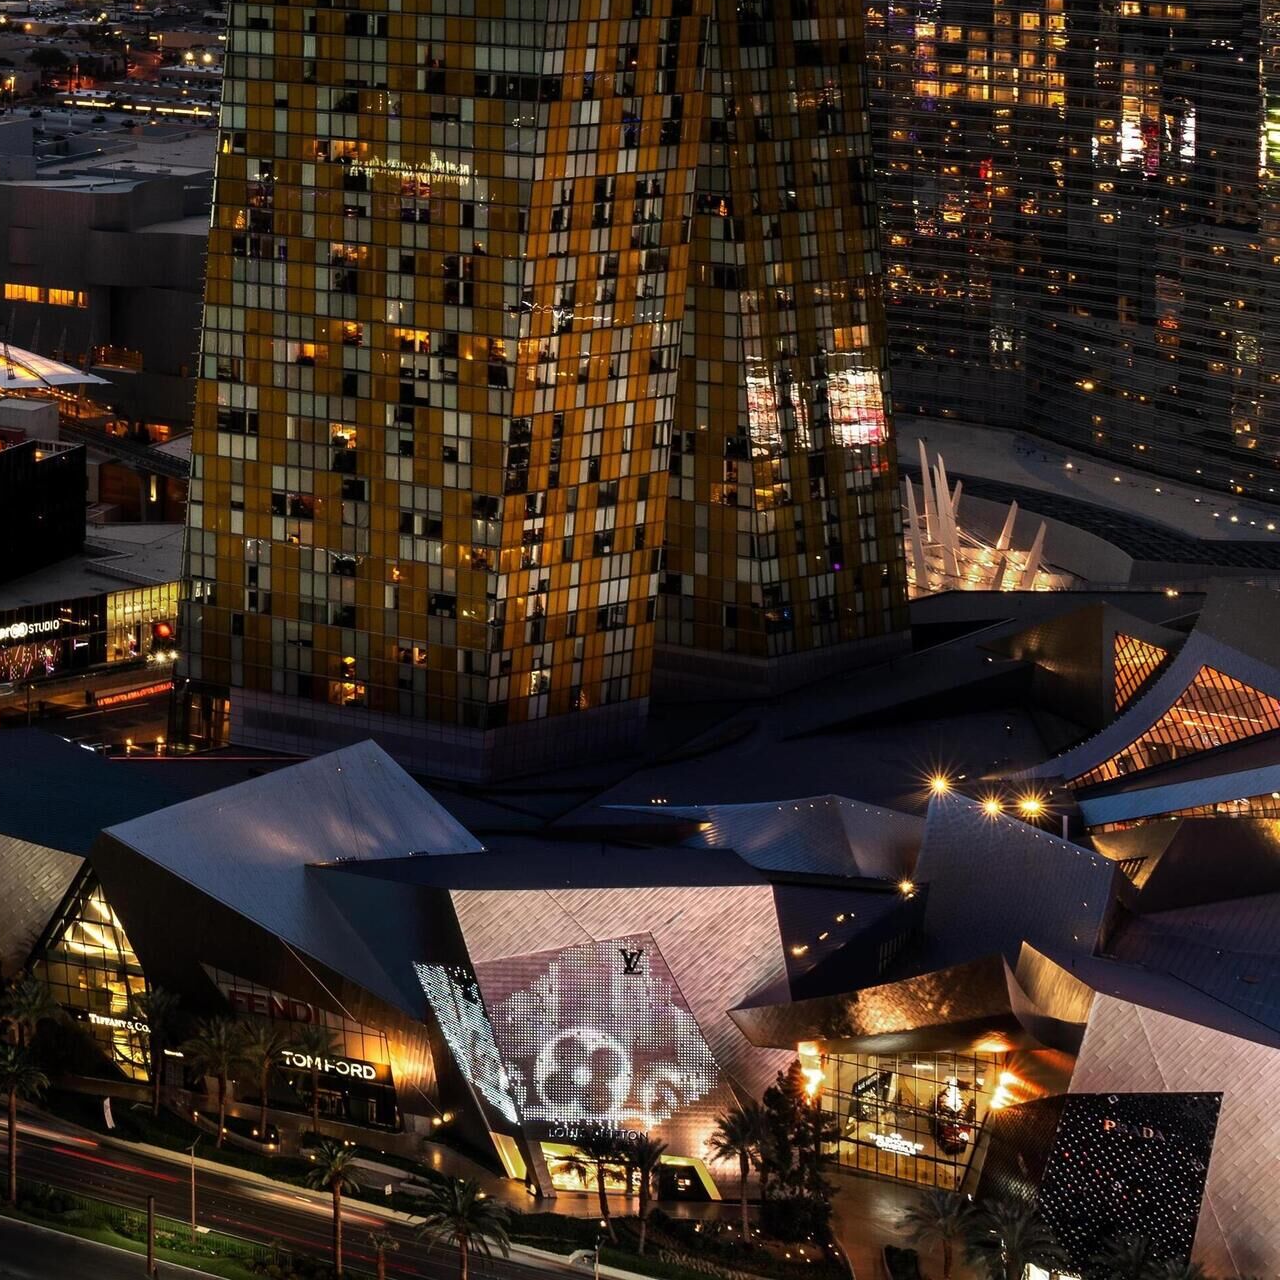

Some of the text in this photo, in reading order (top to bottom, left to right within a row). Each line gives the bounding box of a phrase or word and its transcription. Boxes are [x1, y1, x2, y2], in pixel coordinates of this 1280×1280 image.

[28, 619, 60, 634] STUDIO
[88, 1013, 127, 1028] TIFFANY
[281, 1050, 376, 1080] TOM FORD
